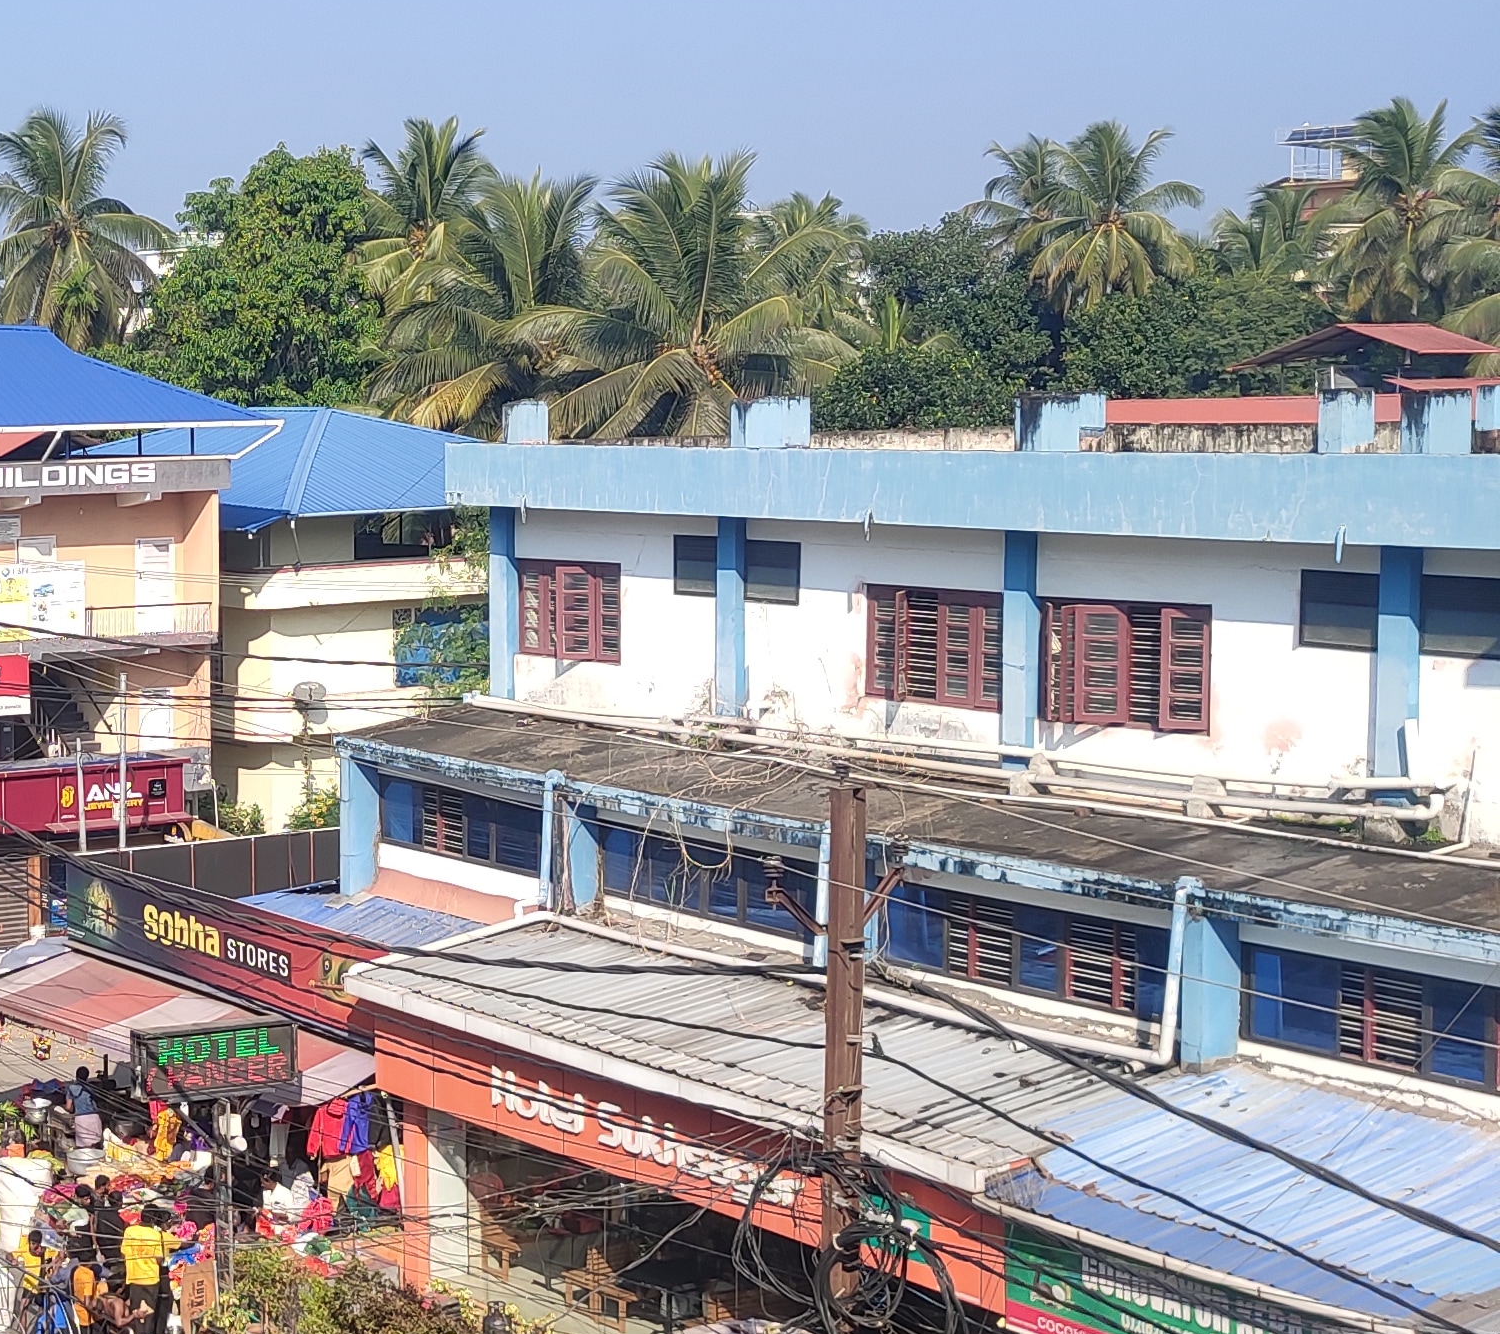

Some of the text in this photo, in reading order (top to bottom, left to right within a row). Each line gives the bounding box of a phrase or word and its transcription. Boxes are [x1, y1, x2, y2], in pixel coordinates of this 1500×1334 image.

[226, 938, 289, 977] STORES
[158, 1028, 280, 1066] HOTEL
[490, 1064, 585, 1134] Hotel
